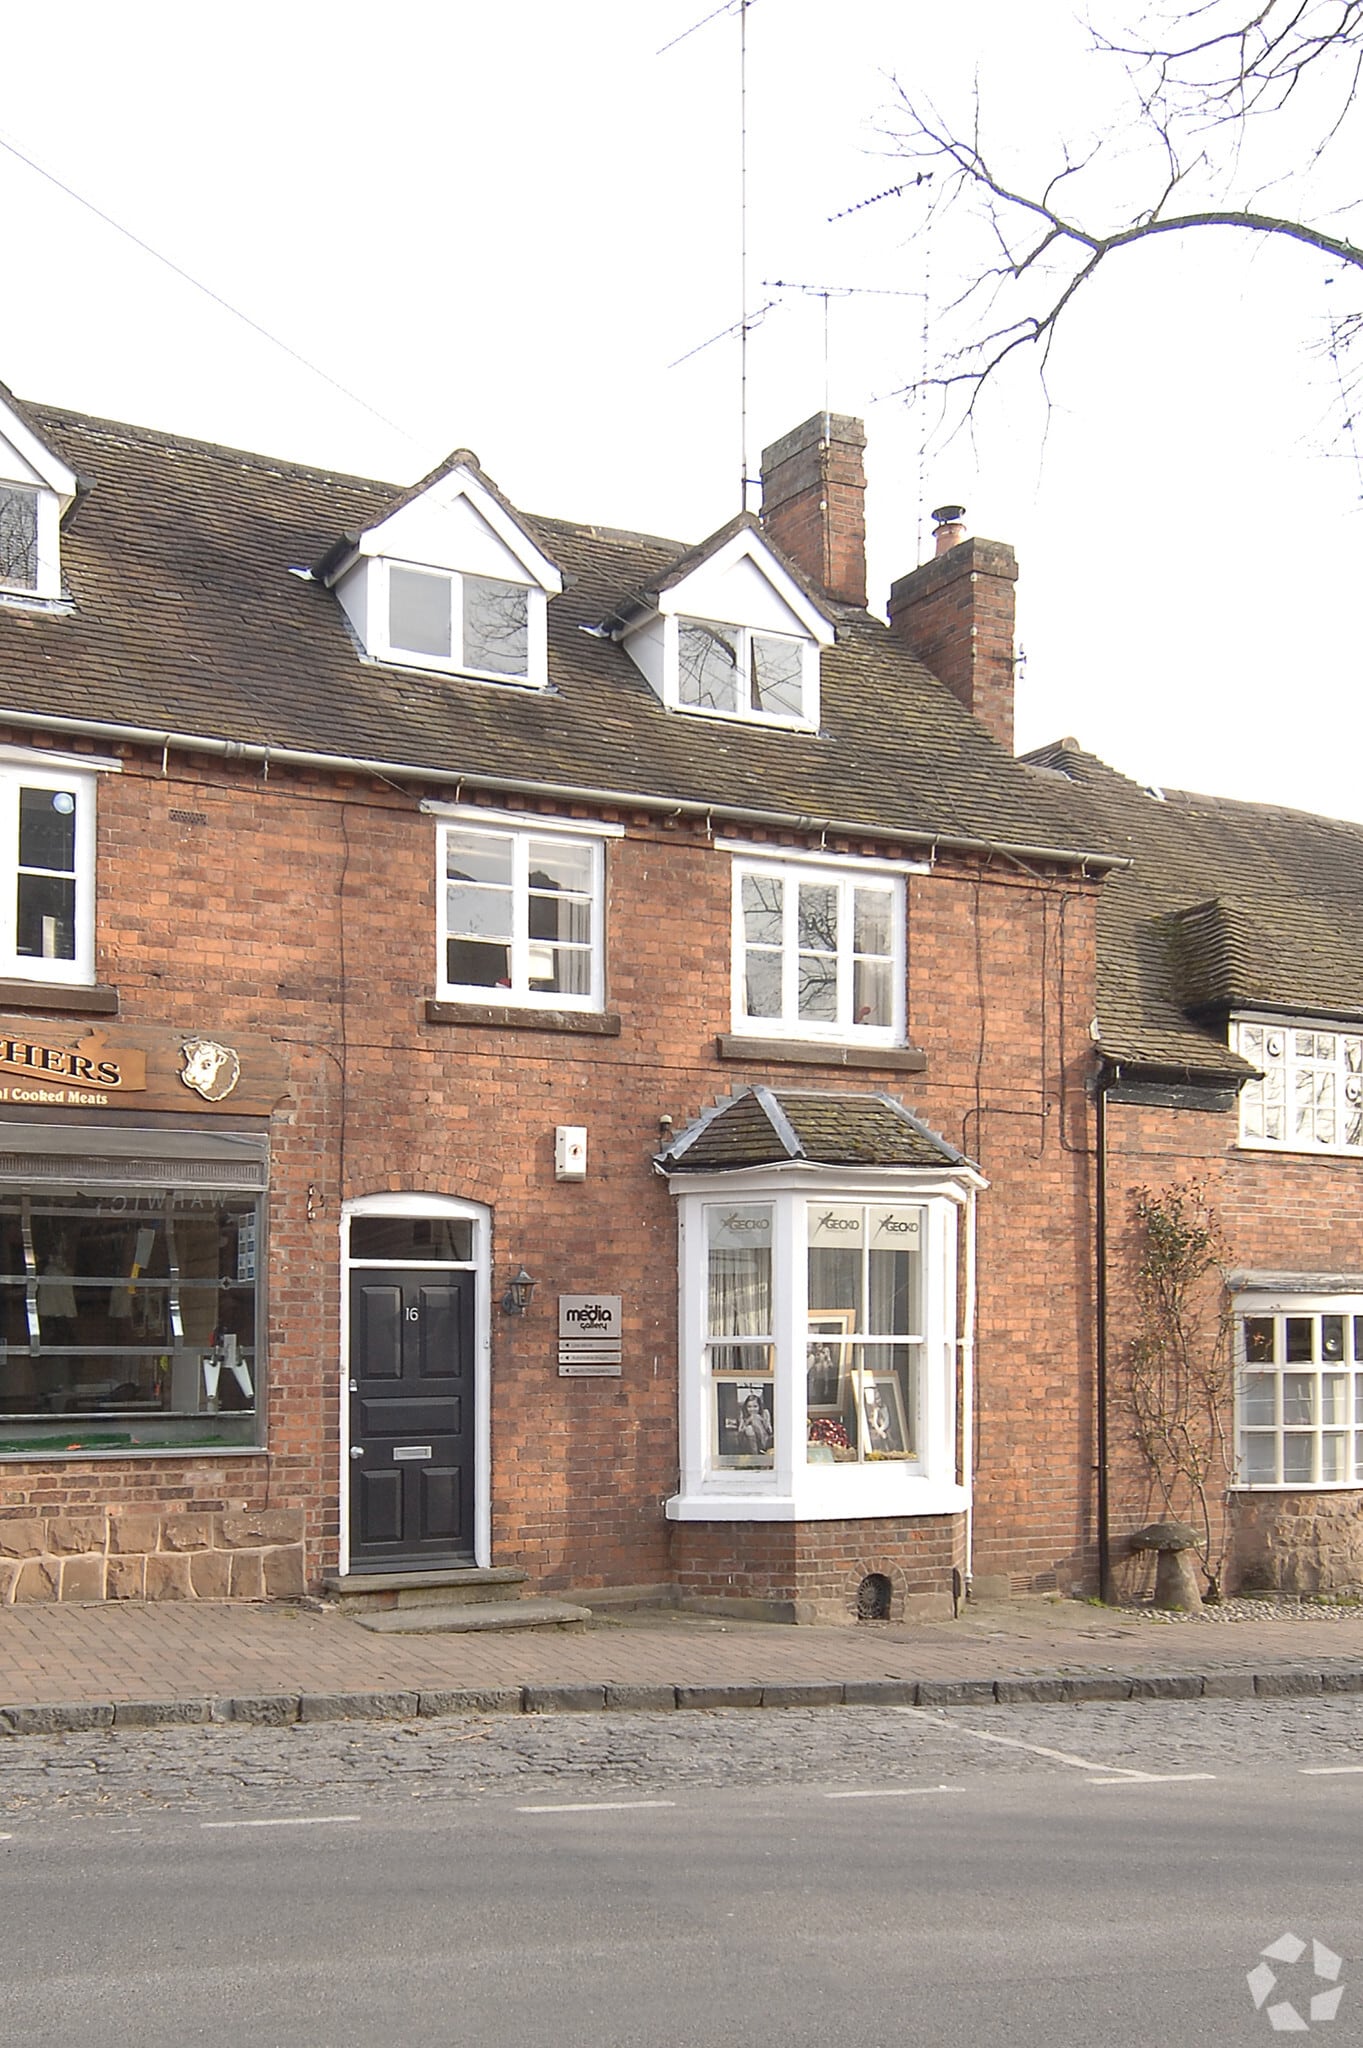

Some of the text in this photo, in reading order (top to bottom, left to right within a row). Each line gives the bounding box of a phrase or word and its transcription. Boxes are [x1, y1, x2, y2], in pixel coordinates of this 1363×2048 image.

[0, 1040, 121, 1086] HERS
[11, 1087, 65, 1103] Cooked
[67, 1090, 109, 1105] Meats
[728, 1217, 770, 1230] GECKO
[825, 1218, 860, 1230] GECKO
[885, 1220, 919, 1233] GECKO
[406, 1306, 419, 1322] 16
[567, 1305, 612, 1321] media
